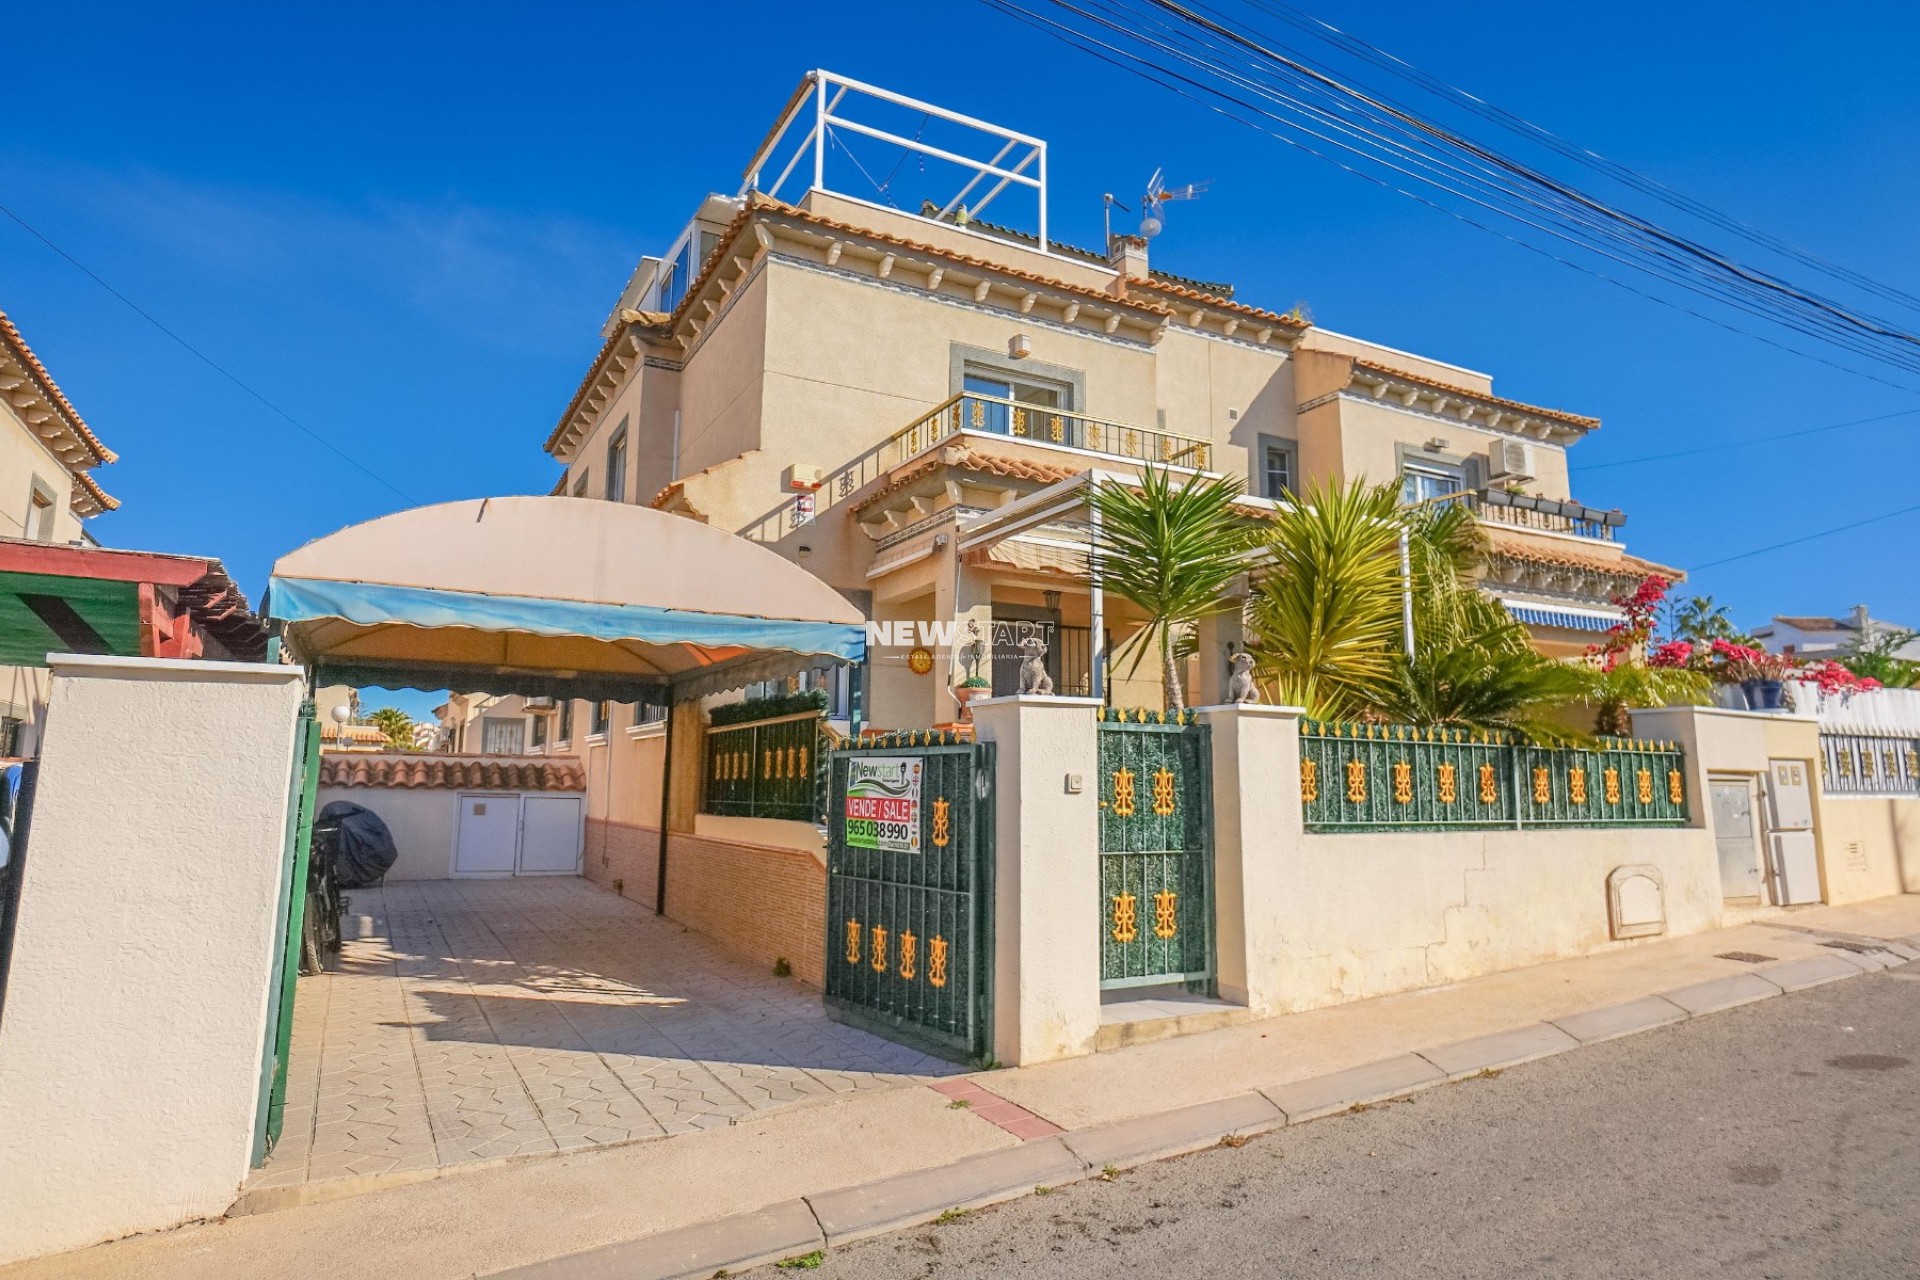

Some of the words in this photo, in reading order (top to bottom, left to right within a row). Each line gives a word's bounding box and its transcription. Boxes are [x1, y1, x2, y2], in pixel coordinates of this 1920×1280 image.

[848, 798, 878, 818] VENDE
[883, 800, 909, 820] SALE
[848, 819, 865, 836] 965
[866, 821, 886, 838] 038
[887, 823, 909, 840] 990
